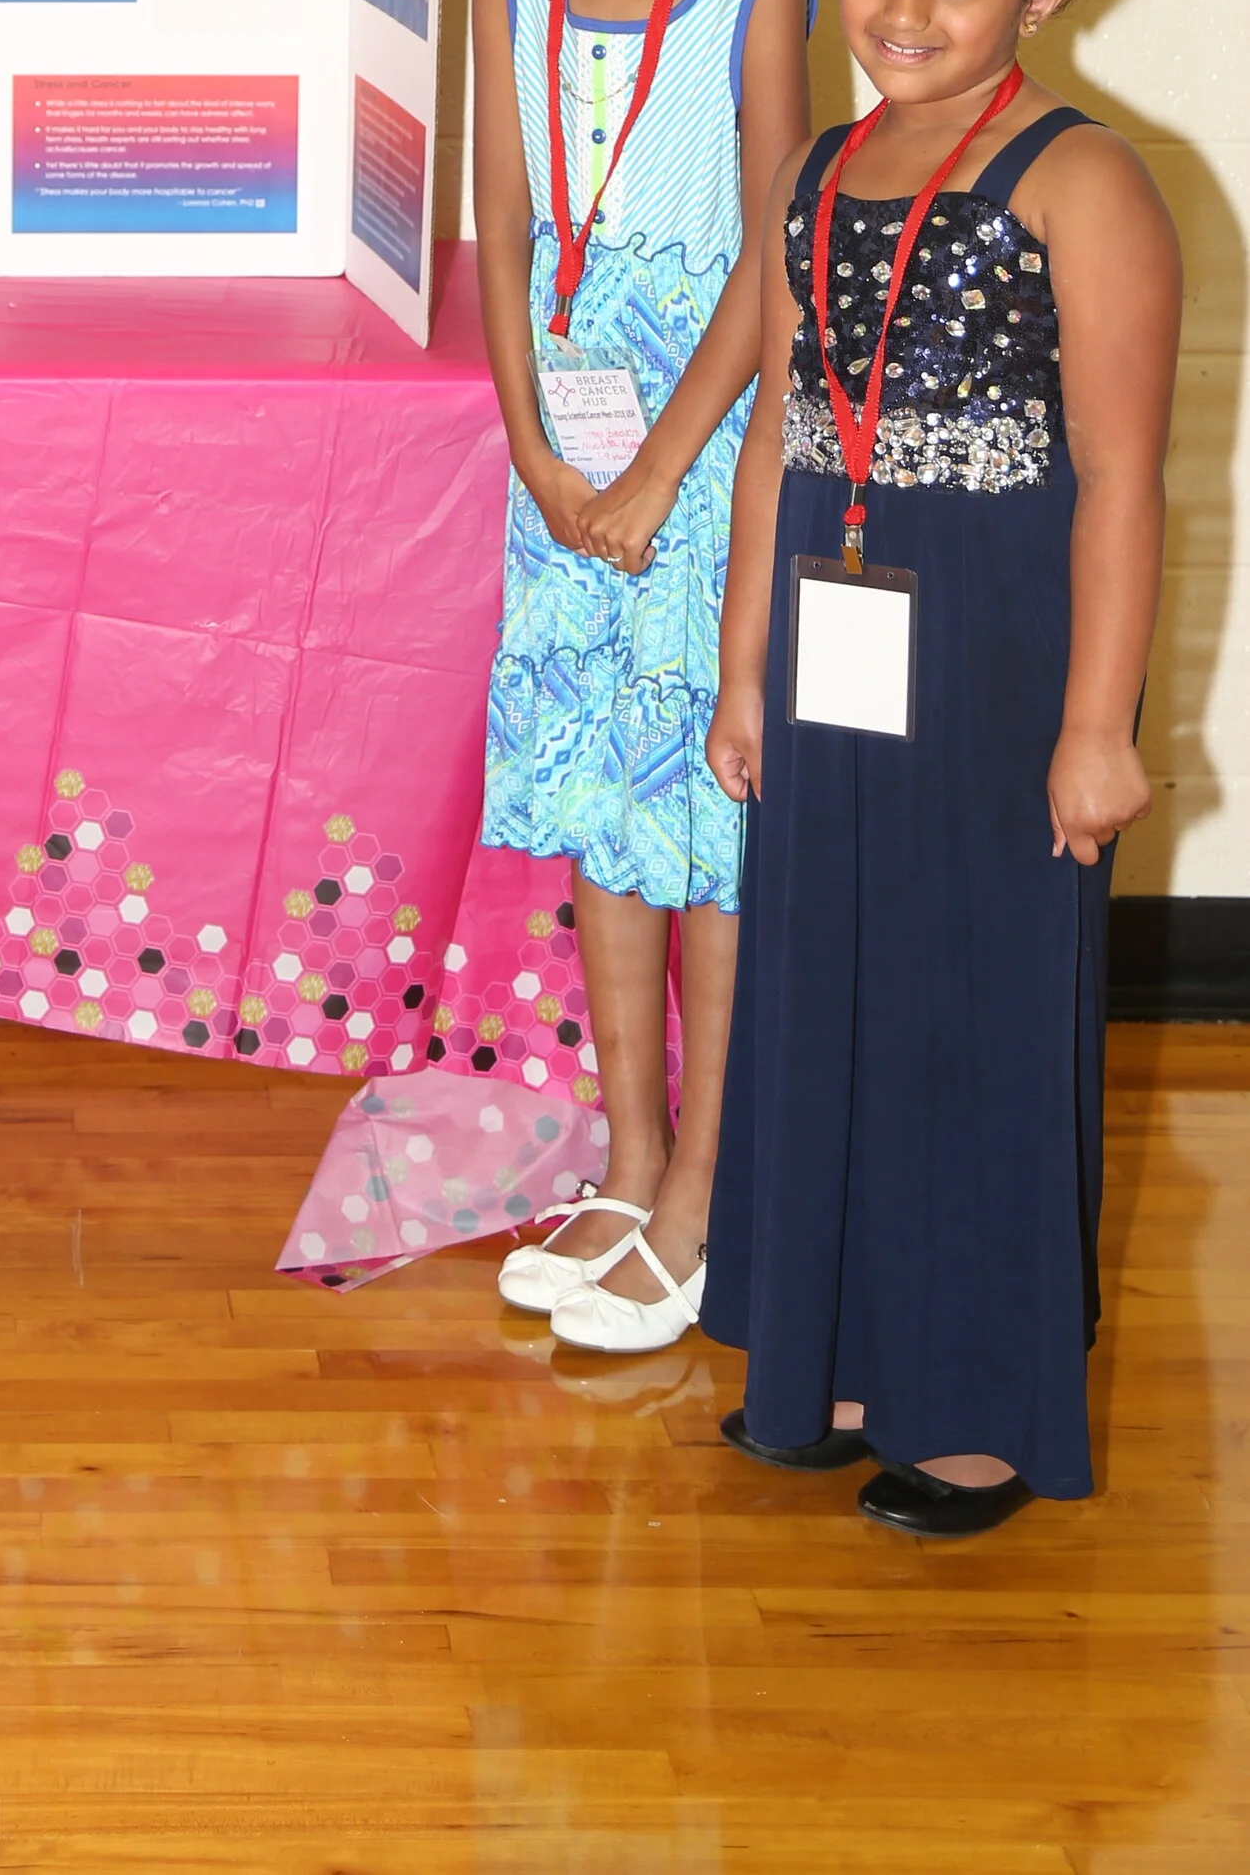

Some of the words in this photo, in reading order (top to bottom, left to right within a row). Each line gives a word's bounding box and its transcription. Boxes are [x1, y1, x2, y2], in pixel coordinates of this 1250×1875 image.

[34, 79, 64, 89] Stress
[66, 79, 88, 89] and
[90, 79, 132, 89] Cancer
[62, 188, 88, 196] makes
[108, 188, 130, 197] body
[153, 188, 195, 197] hospitable
[575, 375, 618, 385] BREAST
[578, 385, 627, 397] CANCER
[582, 397, 608, 407] HUB
